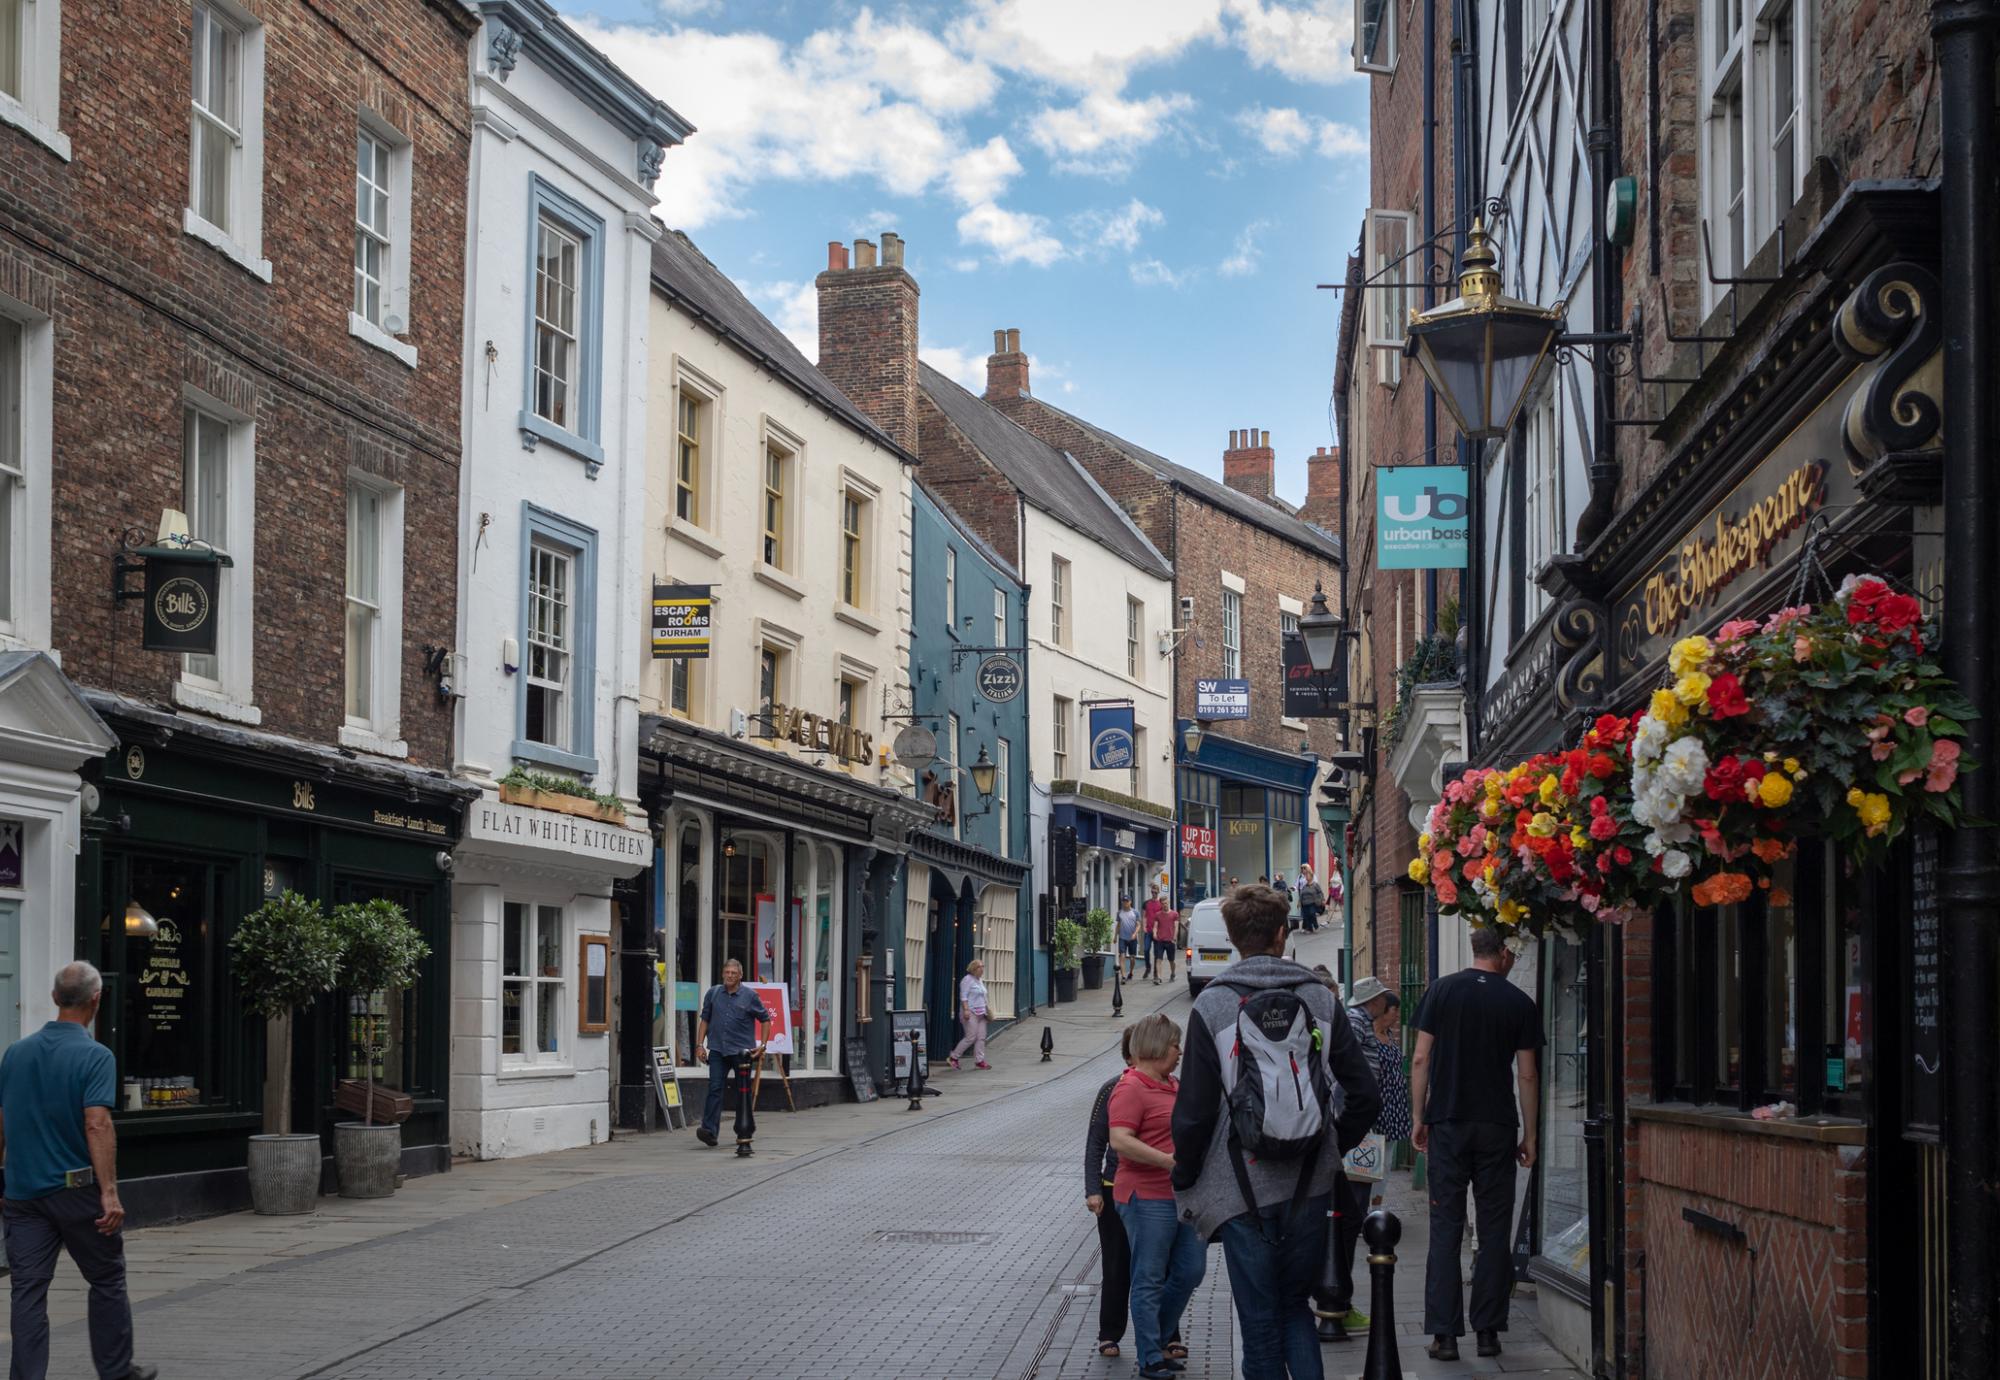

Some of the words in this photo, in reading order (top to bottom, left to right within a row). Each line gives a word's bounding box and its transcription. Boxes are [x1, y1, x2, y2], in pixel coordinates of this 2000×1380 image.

[1644, 572, 1679, 638] The
[1680, 459, 1815, 608] Shakespeare
[165, 592, 196, 614] Bill's
[654, 606, 699, 616] ESCAPE
[668, 616, 708, 626] ROOMS
[660, 629, 701, 637] DURHAM
[987, 688, 1013, 698] ITALIAN
[1198, 681, 1217, 692] SW
[1222, 694, 1235, 702] Let
[293, 781, 315, 810] Bill's
[374, 810, 404, 828] Breakfast
[407, 816, 424, 831] Lunch
[427, 819, 446, 835] Dinner
[482, 810, 522, 835] FLAT
[530, 818, 578, 844] WHITE
[584, 829, 644, 856] KITCHEN
[1186, 828, 1198, 841] UP
[1200, 830, 1211, 844] TO
[1200, 844, 1215, 858] OFF
